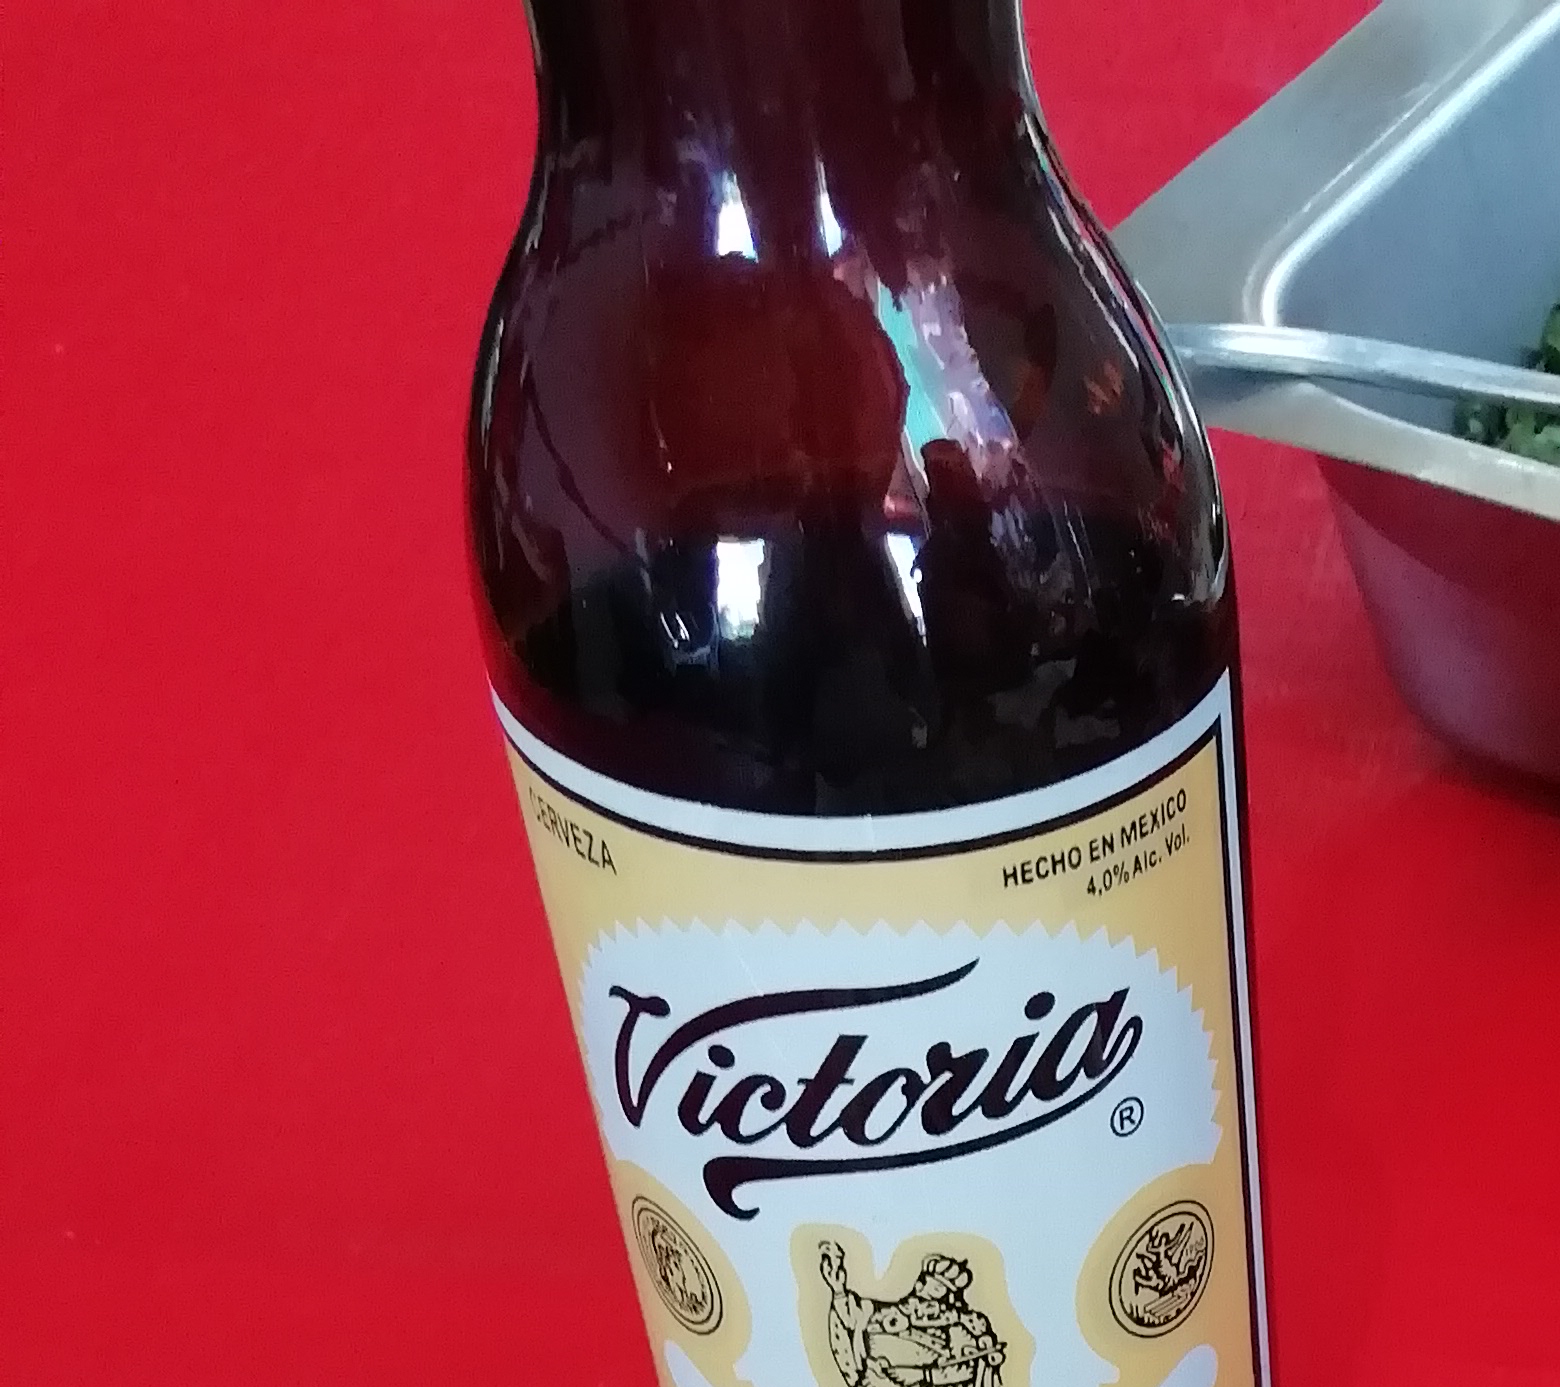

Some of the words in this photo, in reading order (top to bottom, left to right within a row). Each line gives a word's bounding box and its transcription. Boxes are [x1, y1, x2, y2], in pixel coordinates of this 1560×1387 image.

[529, 786, 617, 876] CERVEZA
[1002, 846, 1082, 888] HECHO
[1089, 832, 1115, 864] EN
[1120, 788, 1187, 848] MEXICO
[1132, 849, 1163, 879] Alc.
[1164, 823, 1190, 856] Vol.
[608, 956, 1144, 1221] Victoria
